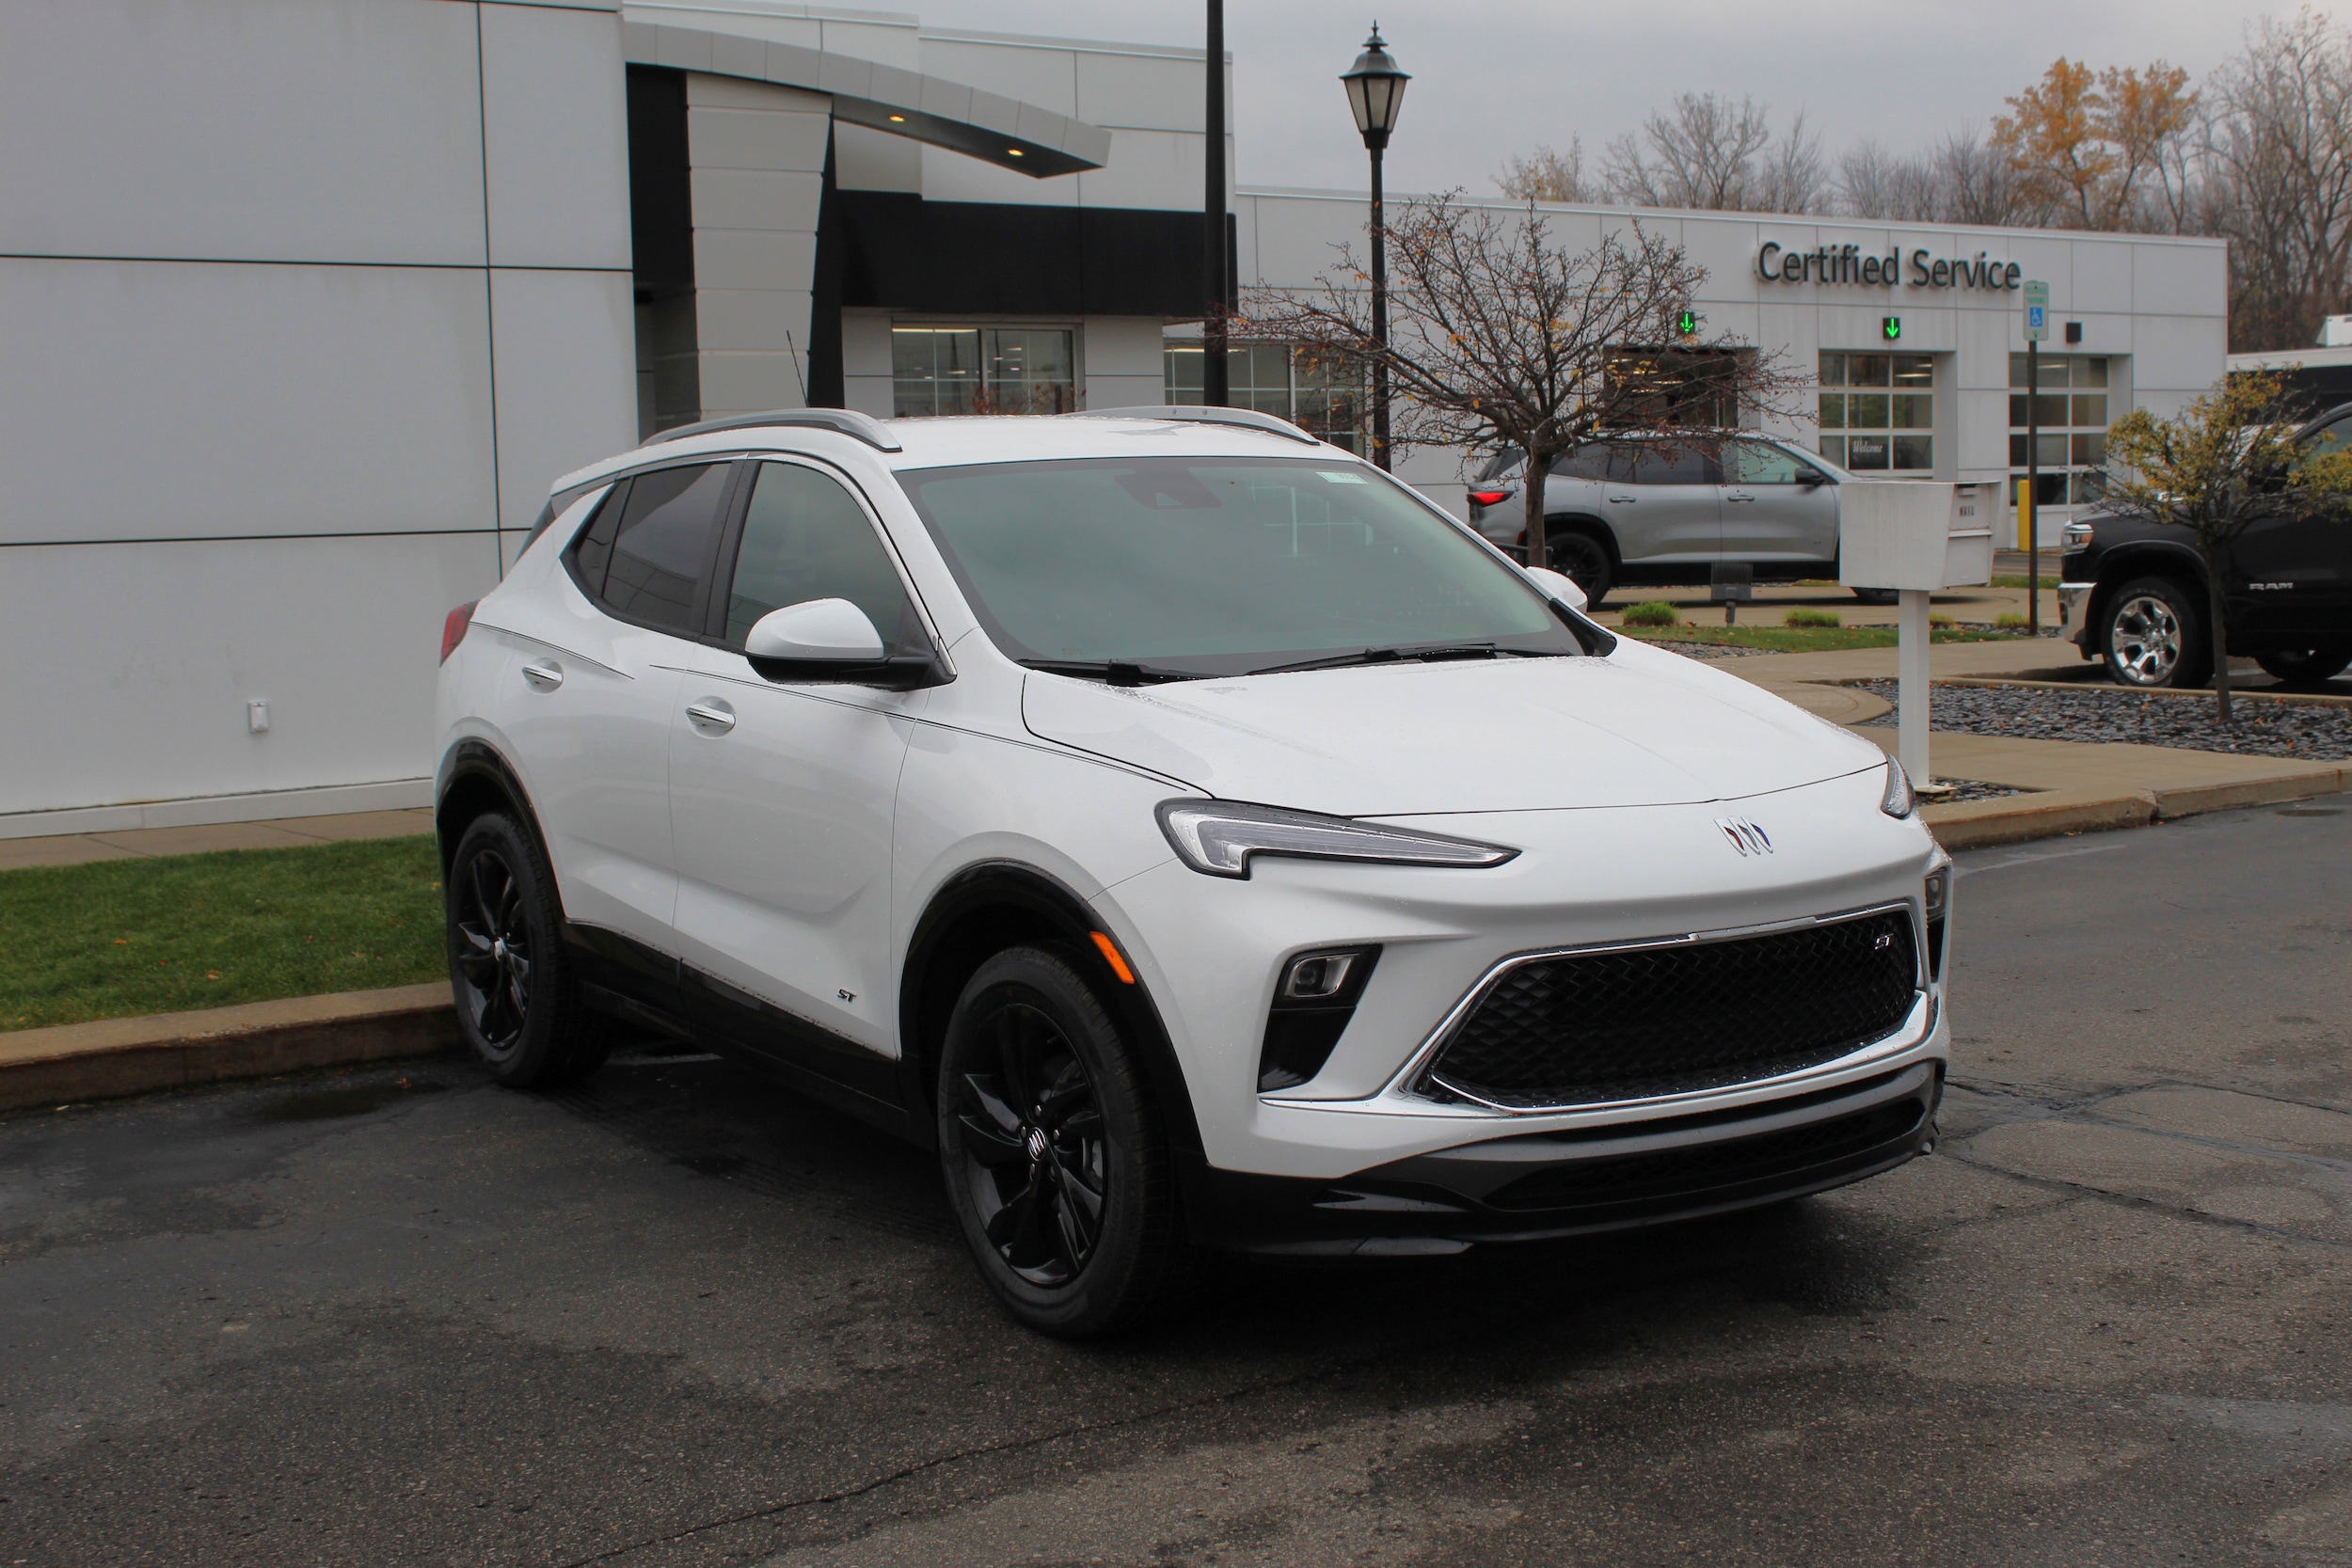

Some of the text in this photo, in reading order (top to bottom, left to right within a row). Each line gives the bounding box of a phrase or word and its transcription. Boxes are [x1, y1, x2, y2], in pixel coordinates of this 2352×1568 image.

[1758, 241, 2022, 291] Certified Service
[1853, 438, 1883, 453] Welcome
[1959, 505, 1976, 516] MAIL
[836, 989, 857, 1003] ST
